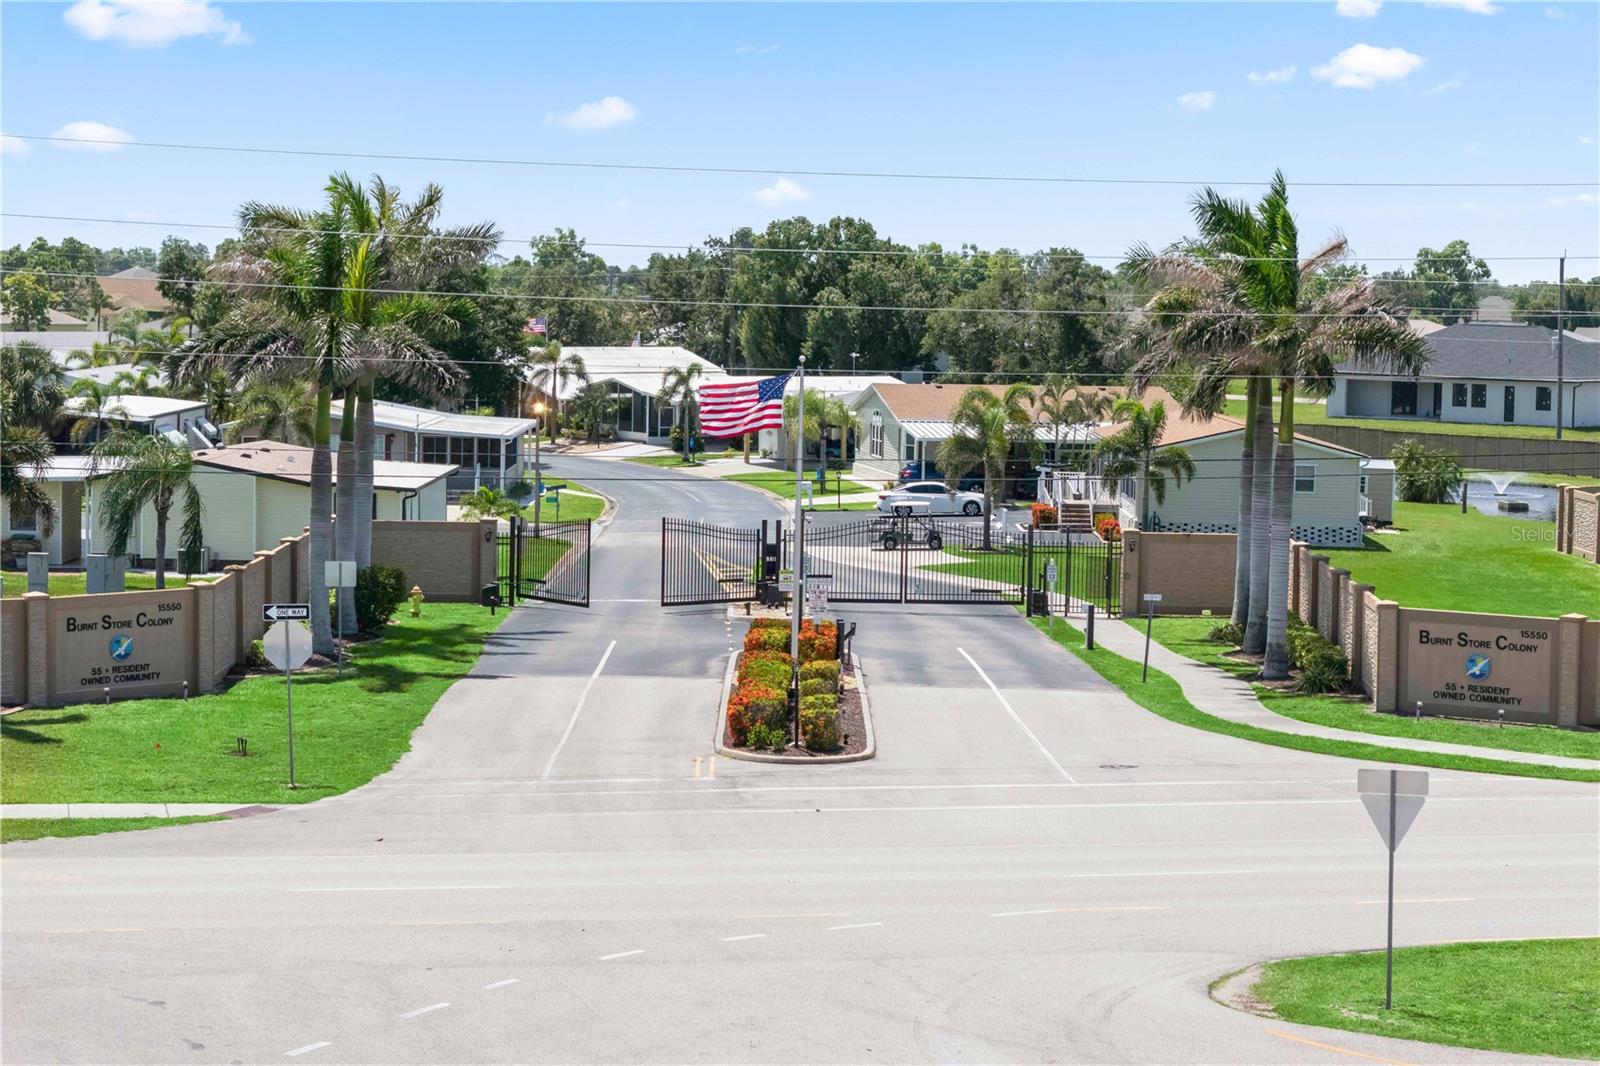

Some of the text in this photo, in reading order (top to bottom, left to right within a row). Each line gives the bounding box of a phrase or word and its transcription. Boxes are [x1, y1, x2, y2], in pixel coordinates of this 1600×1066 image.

[157, 602, 182, 612] 15550
[1520, 630, 1548, 640] 15550
[91, 667, 102, 676] 55
[111, 663, 151, 674] RESIDENT
[80, 671, 161, 686] OWNED COMMUNITY
[1445, 682, 1457, 692] 55
[1467, 684, 1511, 696] RESIDENT
[1433, 690, 1522, 706] OWNED COMMUNITY
